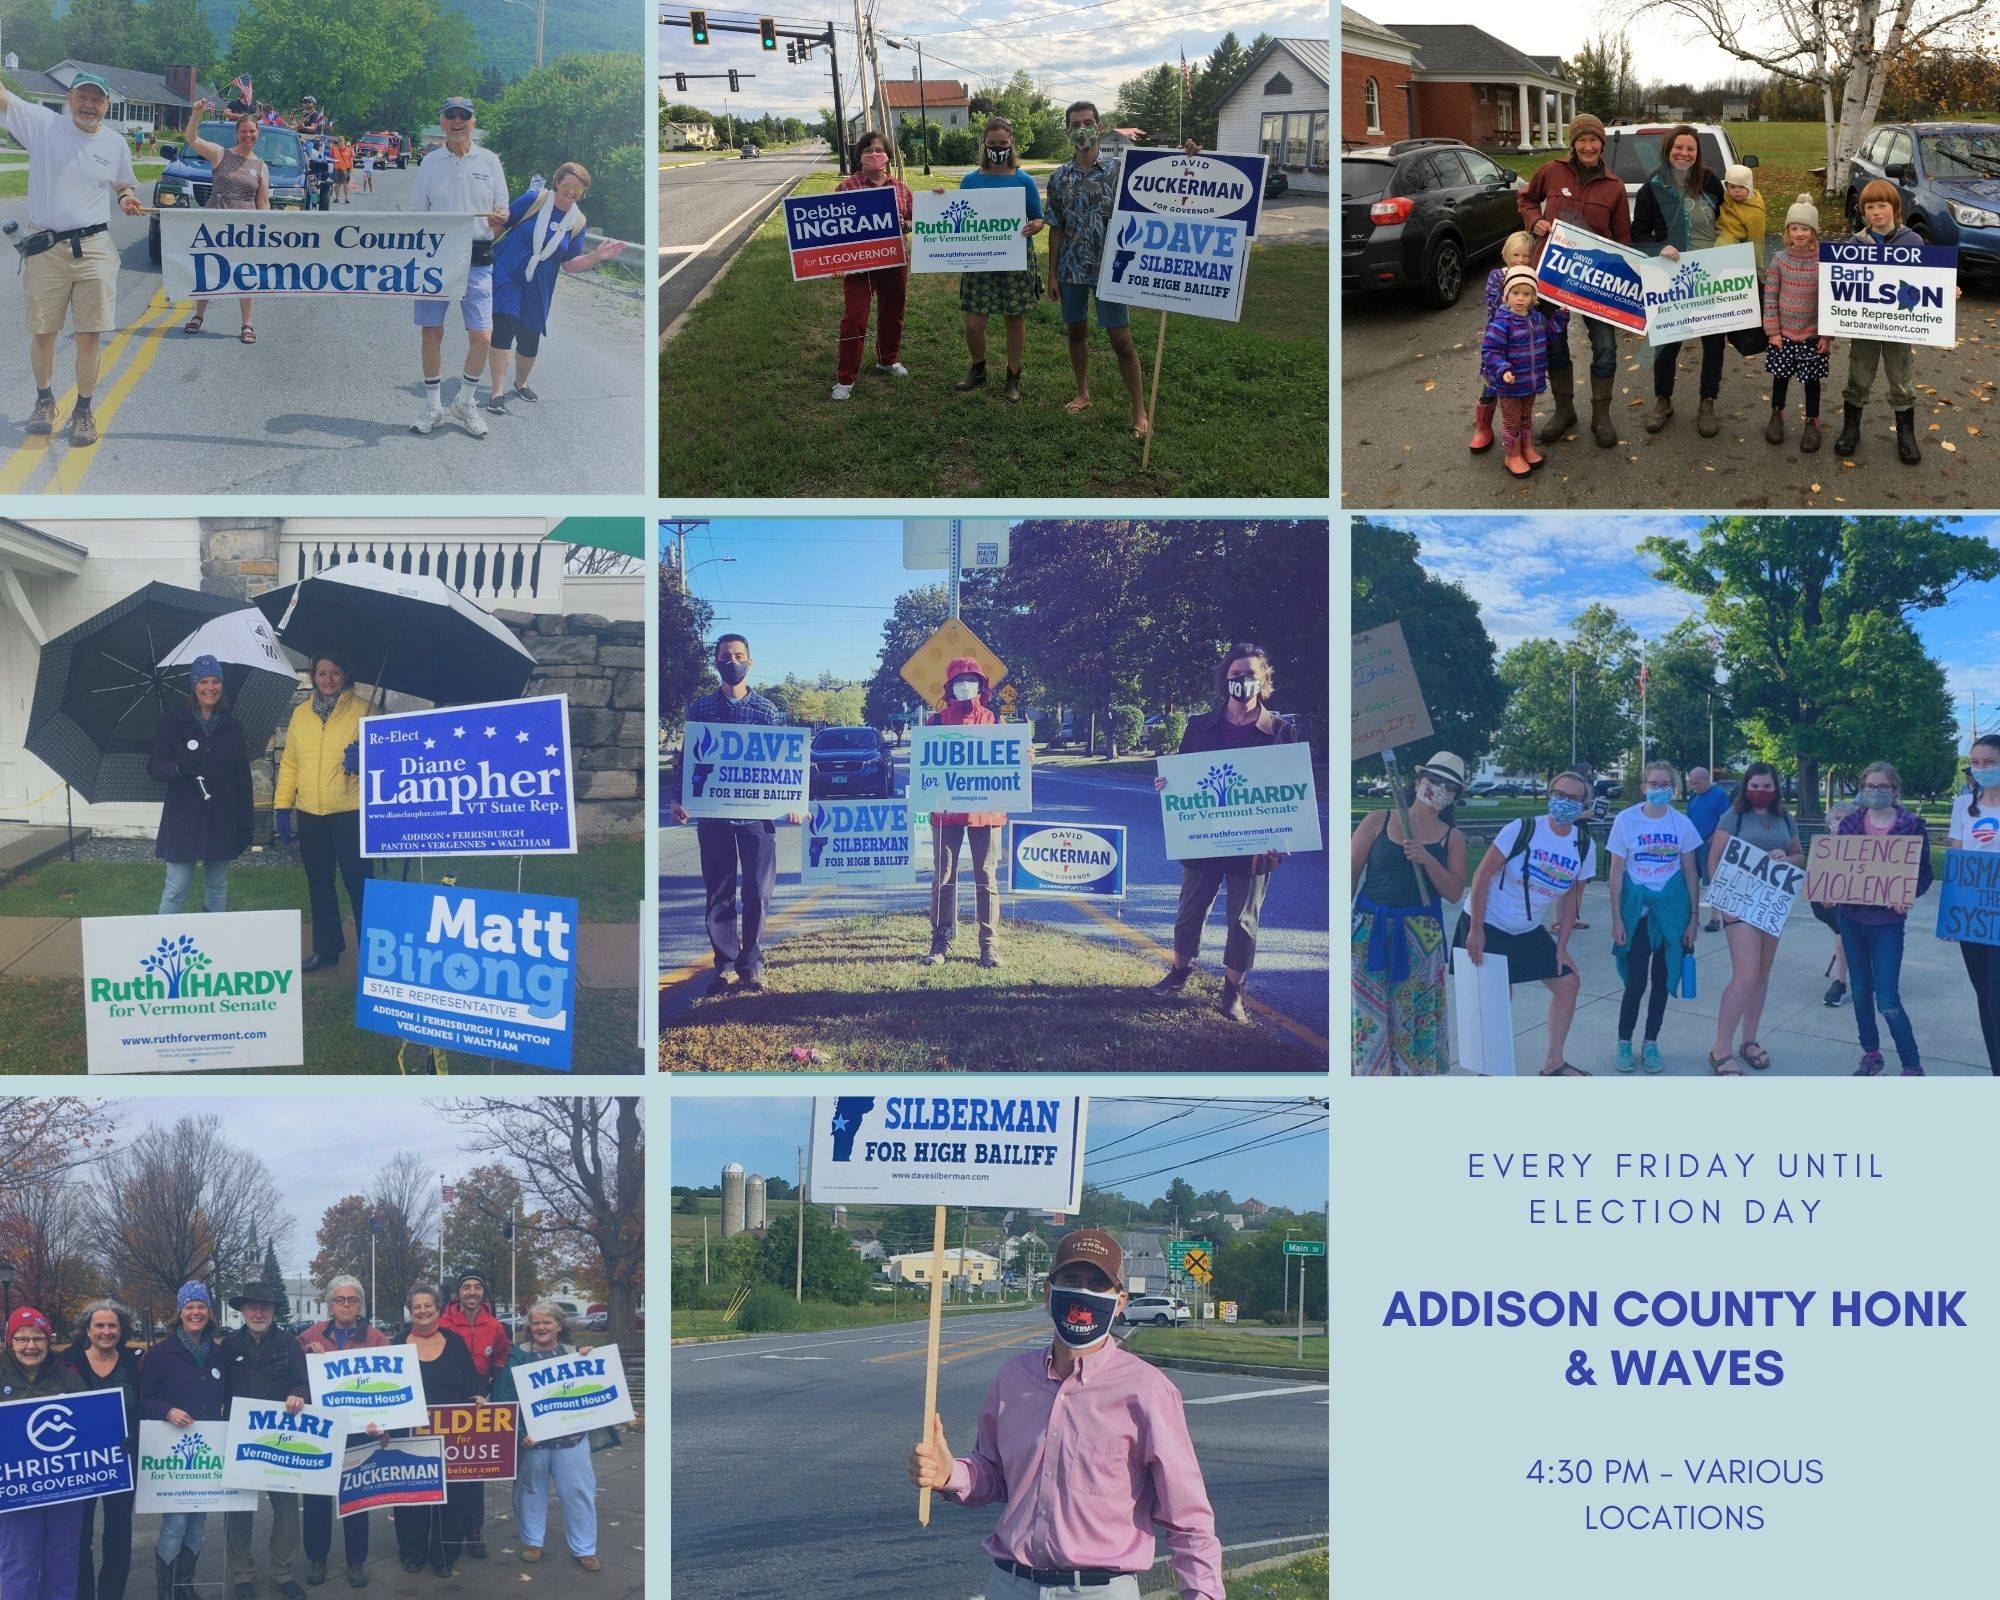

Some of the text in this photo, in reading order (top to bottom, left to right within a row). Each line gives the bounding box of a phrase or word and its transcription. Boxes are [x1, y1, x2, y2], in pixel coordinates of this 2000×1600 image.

[987, 148, 1010, 163] VOTE
[1171, 159, 1210, 169] DAVID
[1132, 175, 1244, 200] ZUCKERMAN
[793, 203, 857, 222] Debbie
[1152, 202, 1215, 215] FOR GOVERNOR
[795, 213, 893, 240] INGRAM
[915, 218, 1021, 235] Ruth HARDY
[190, 223, 445, 258] Addison County
[923, 235, 937, 243] for
[939, 234, 979, 243] Vermont
[1143, 220, 1238, 258] DAVE
[803, 258, 817, 270] for
[818, 247, 898, 266] LT.GOVERNOR
[929, 251, 1007, 259] www.ruthforvermont.com
[1572, 252, 1593, 265] DAVID
[1831, 245, 1921, 263] VOTE FOR
[189, 253, 443, 294] Democrats
[1139, 254, 1233, 281] SILBERMAN
[1831, 265, 1875, 282] Barb
[1128, 275, 1231, 299] FOR HIGH BAILIFF
[1566, 278, 1614, 299] FOR LIEUTENANT
[1646, 275, 1755, 306] Ruth HARDY
[1657, 293, 1748, 314] for Vermont Senate
[1656, 308, 1753, 330] www.ruthforvermont.com
[1830, 305, 1942, 324] State Representative
[1840, 320, 1929, 334] barbarawilsonvt.com
[1228, 680, 1261, 698] VOTE
[369, 731, 419, 745] Re-Elect
[720, 731, 804, 762] DAVE
[920, 740, 1020, 766] JUBILEE
[400, 756, 466, 776] Diane
[719, 766, 803, 785] SILBERMAN
[368, 760, 561, 815] Lanpher
[921, 772, 1021, 791] for Vermont
[709, 788, 802, 801] FOR HIGH BAILIFF
[1165, 783, 1307, 811] Ruth HARDY
[368, 810, 448, 820] www.dianelanpher.com
[466, 800, 564, 815] VT State Rep.
[1178, 804, 1298, 822] for Vermont Senate
[832, 805, 907, 832] DAVE
[401, 829, 524, 841] ADDISON FERRISBURGH
[1052, 832, 1083, 840] DAVID
[1188, 825, 1293, 840] www.ruthforvermont.com
[381, 839, 551, 851] PANTON VERGENNES WALTHAM
[833, 837, 908, 852] SILBERMAN
[1816, 838, 1921, 865] SILENCE
[825, 856, 909, 867] FOR HIGH BAILIFF
[1022, 847, 1111, 866] ZUCKERMAN
[1041, 870, 1091, 880] FOR GOVERNOR
[1724, 839, 1804, 895] BLACK
[1714, 863, 1792, 916] LIVES
[1807, 870, 1918, 906] VIOLENCE
[1704, 880, 1780, 934] MATTER
[426, 895, 570, 962] Matt
[367, 927, 569, 1020] Birong
[91, 970, 293, 1002] Ruth HARDY
[108, 999, 277, 1017] for Vermont Senate
[370, 983, 517, 1018] STATE REPRESENTATIVE
[373, 1005, 550, 1046] ADDISON FERRISBURGH PANTON
[121, 1031, 267, 1046] www.ruthforvermont.com
[397, 1021, 518, 1053] VERGENNES WALTHAM
[885, 1097, 1060, 1133] SILBERMAN
[865, 1142, 1058, 1166] FOR HIGH BAILIFF
[892, 1171, 989, 1181] www.davesilberman.com
[1072, 1242, 1109, 1255] VERMONT
[1288, 1244, 1309, 1252] Main
[324, 1355, 404, 1380] MARI
[528, 1359, 605, 1389] MARI
[356, 1376, 370, 1389] for
[562, 1381, 575, 1395] for
[326, 1393, 407, 1405] Vermont House
[536, 1392, 611, 1413] Vermont House
[248, 1410, 334, 1439] MARI
[277, 1433, 293, 1446] for
[457, 1436, 471, 1445] for
[242, 1447, 325, 1467] Vermont House
[446, 1444, 500, 1460] OUSE
[0, 1446, 124, 1481] HRISTINE
[141, 1455, 183, 1470] Ruth
[32, 1469, 118, 1492] GOVERNOR
[150, 1471, 212, 1481] for Vermont
[343, 1464, 439, 1492] ZUCKERMAN
[156, 1489, 240, 1497] www.ruthforvermont.com
